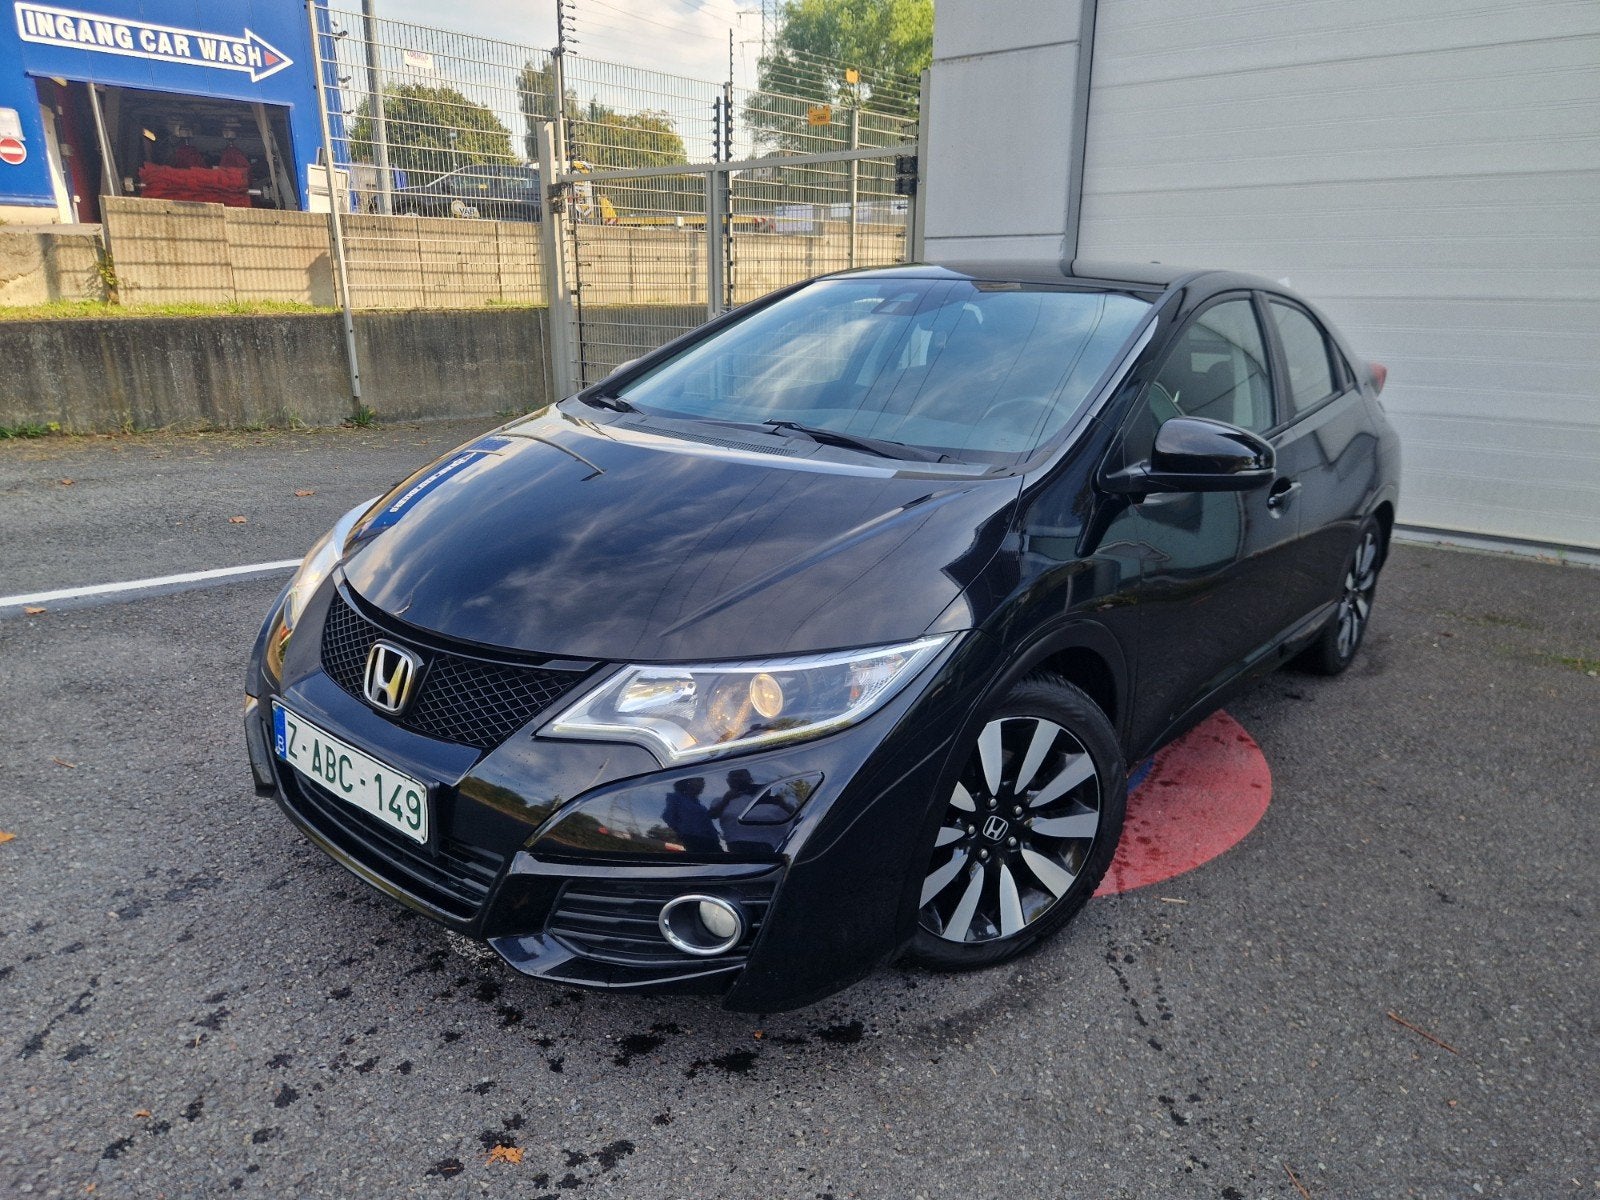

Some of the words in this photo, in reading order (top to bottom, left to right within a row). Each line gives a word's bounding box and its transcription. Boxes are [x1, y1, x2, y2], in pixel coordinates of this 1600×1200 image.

[25, 10, 134, 49] INGANG
[140, 29, 191, 57] CAR
[197, 37, 262, 67] WASH
[287, 721, 421, 831] Z-ABC-149
